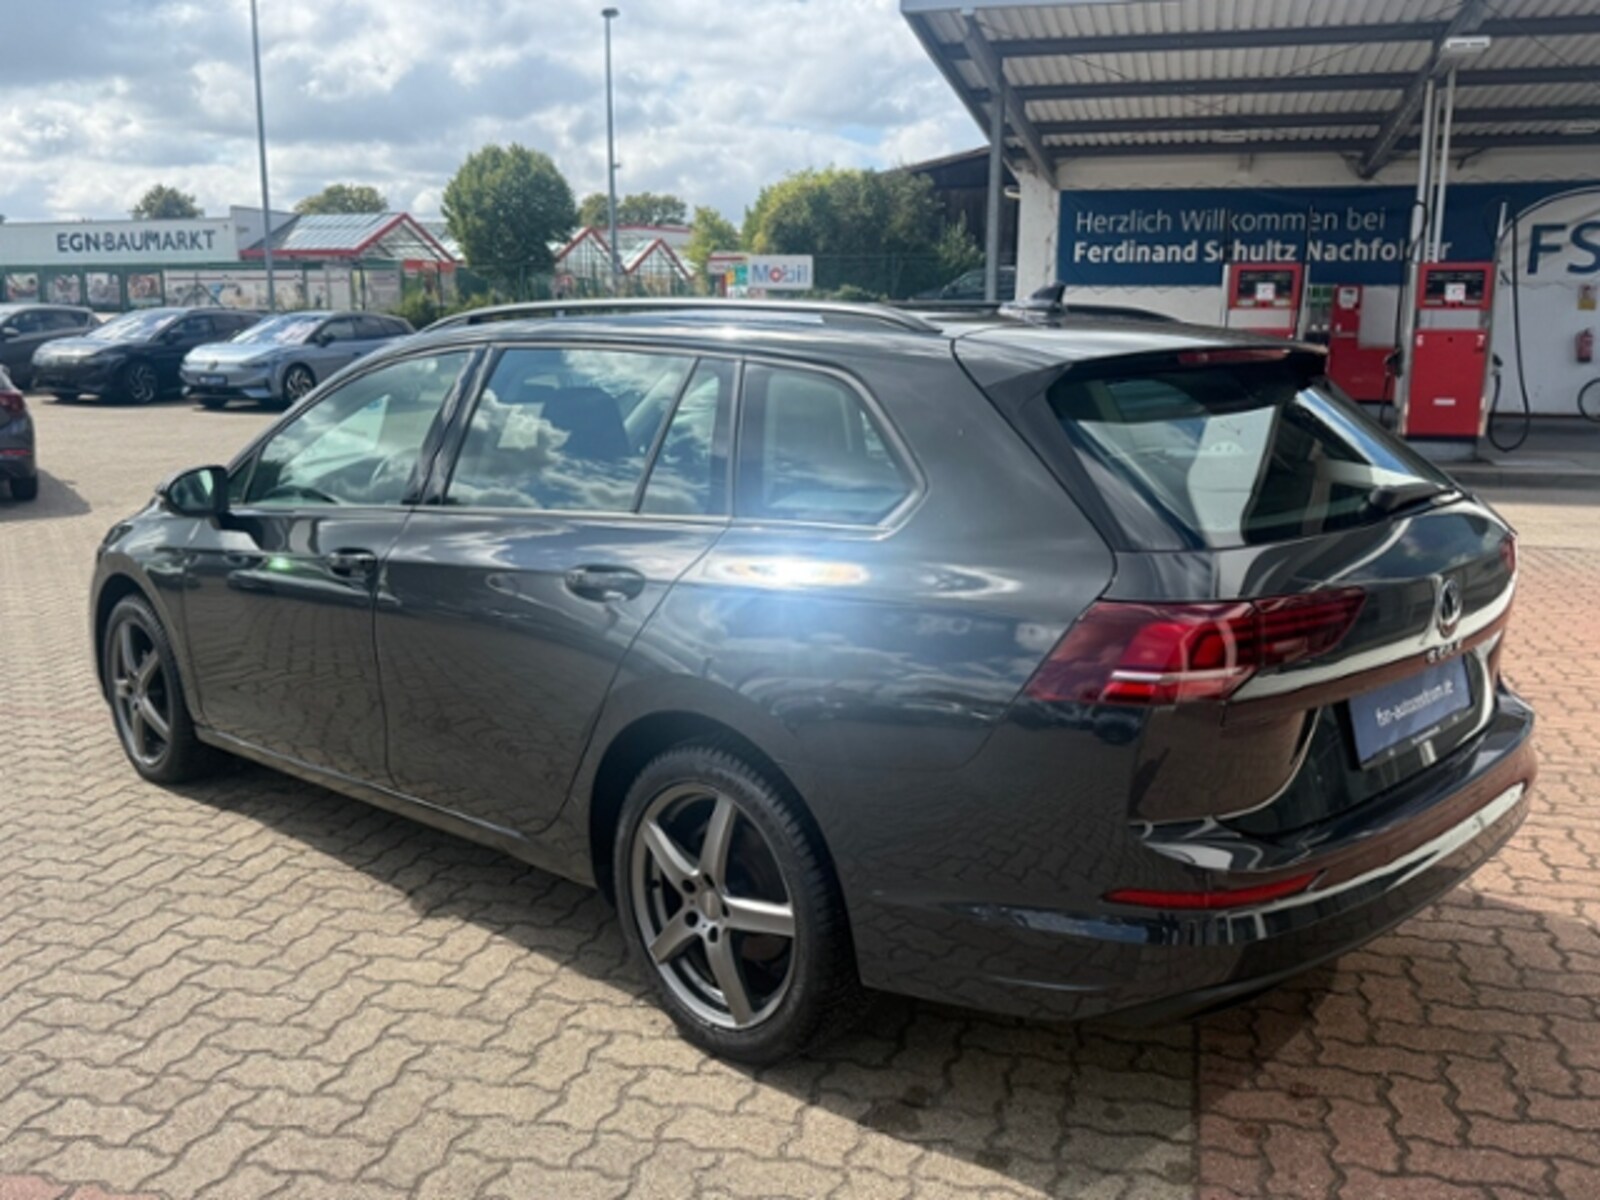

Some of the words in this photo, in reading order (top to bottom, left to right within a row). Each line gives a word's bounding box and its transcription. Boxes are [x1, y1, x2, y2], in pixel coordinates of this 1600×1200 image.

[1075, 208, 1172, 234] Herzlich
[1179, 206, 1339, 233] Willkommen
[1346, 206, 1386, 231] bei
[1073, 239, 1199, 264] Ferdinand
[751, 263, 808, 284] Mobil
